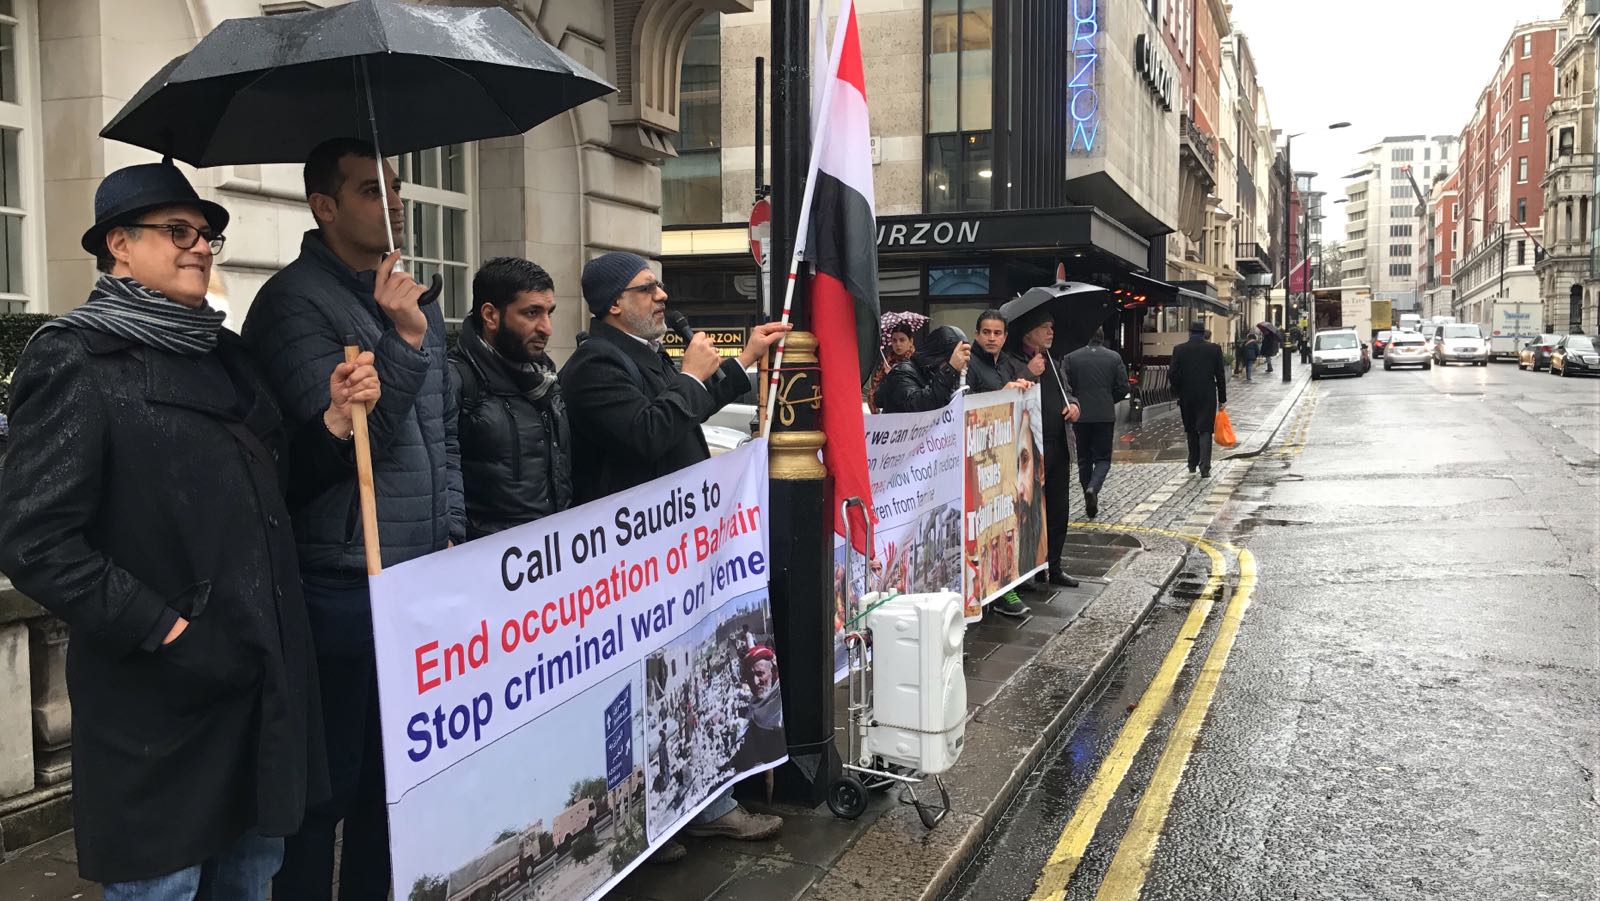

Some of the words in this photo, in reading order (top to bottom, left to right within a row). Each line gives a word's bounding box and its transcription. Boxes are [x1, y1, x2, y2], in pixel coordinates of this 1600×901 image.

[1068, 0, 1099, 152] URZON
[871, 430, 889, 445] we
[890, 427, 908, 444] can
[910, 462, 933, 482] food
[501, 531, 562, 592] Call
[571, 525, 606, 565] on
[614, 487, 696, 546] Saudis
[702, 479, 720, 512] to
[892, 495, 916, 515] from
[414, 620, 489, 695] End
[501, 555, 658, 654] occupation
[666, 533, 688, 575] of
[695, 502, 761, 562] Bahrain
[407, 690, 493, 763] Stop
[504, 614, 624, 711] criminal
[631, 596, 676, 643] war
[682, 581, 705, 615] on
